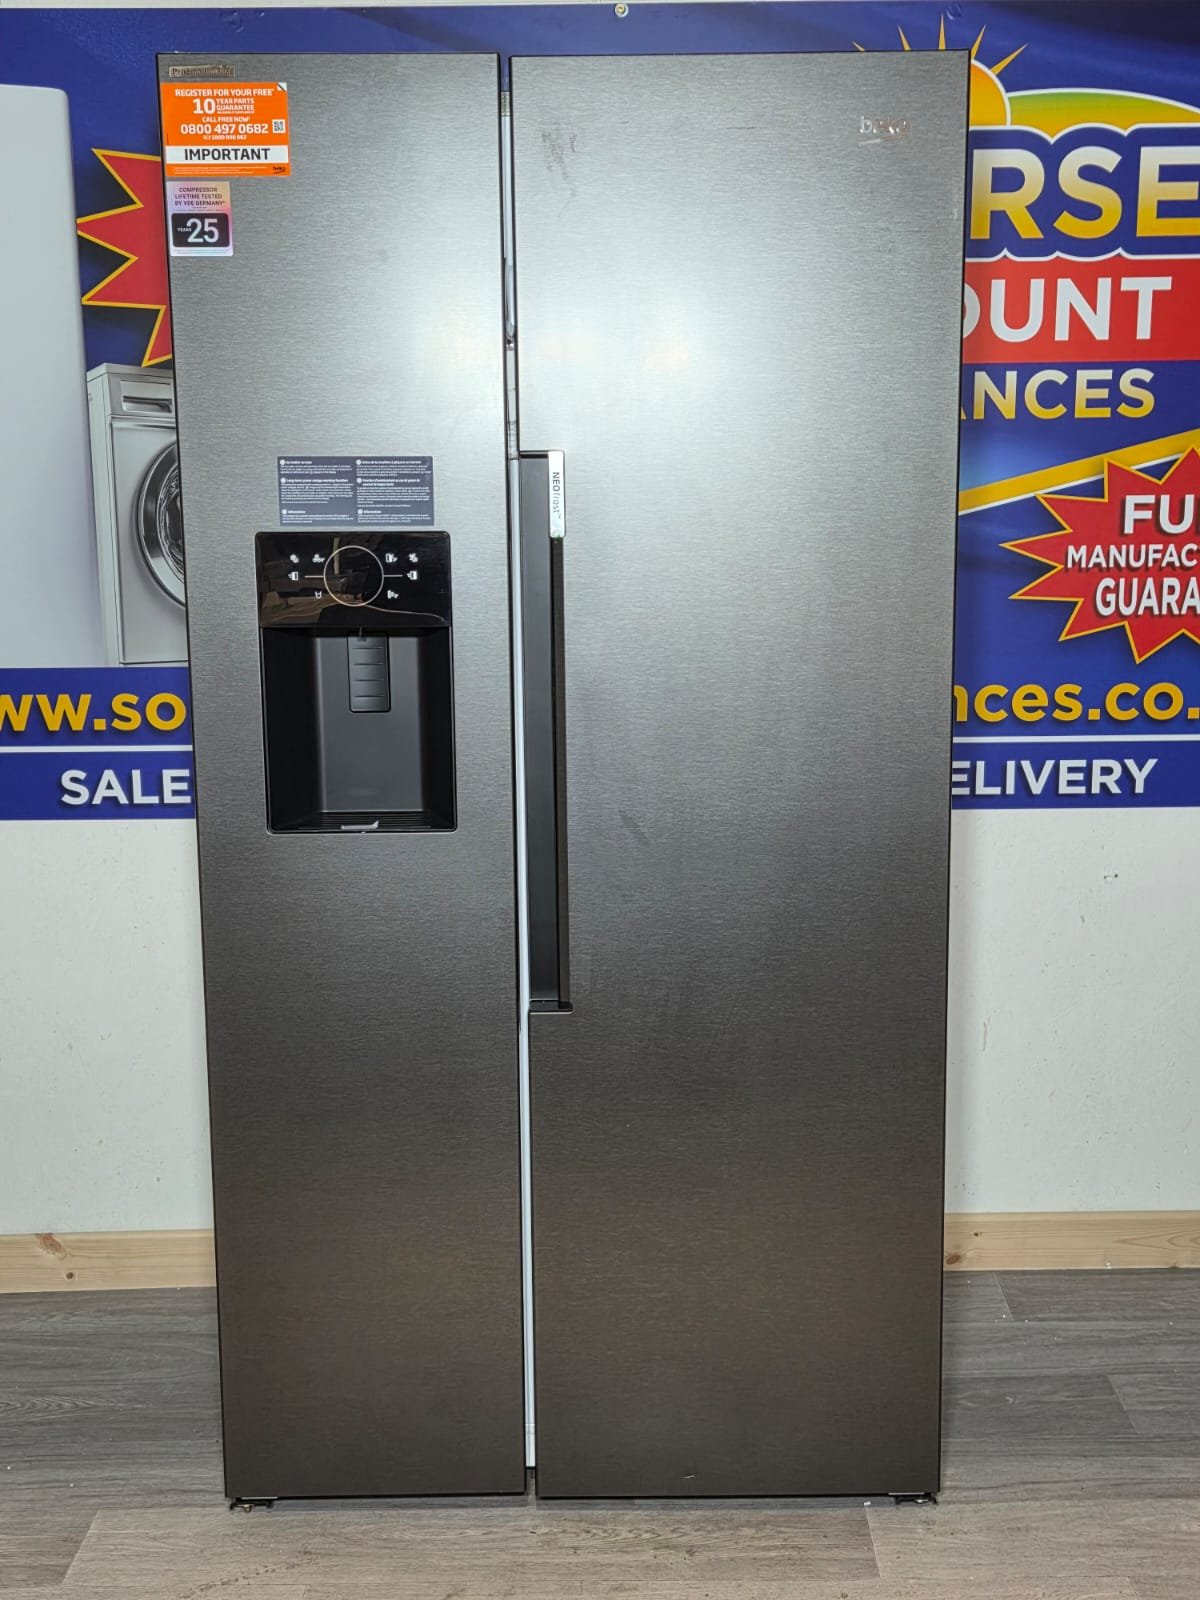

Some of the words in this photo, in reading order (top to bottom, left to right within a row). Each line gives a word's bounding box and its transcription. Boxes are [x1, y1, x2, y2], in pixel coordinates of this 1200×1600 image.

[175, 88, 213, 97] REGISTER
[213, 88, 230, 97] FOR
[230, 88, 252, 96] YOUR
[193, 98, 216, 114] 10
[180, 124, 212, 134] 0800
[214, 124, 236, 134] 497
[238, 123, 269, 134] 0682
[184, 148, 270, 161] IMPORTANT
[970, 146, 1200, 240] RSE
[186, 217, 219, 243] 25
[960, 367, 1155, 420] NCES
[1067, 543, 1200, 569] MANUFAC
[1095, 576, 1200, 616] GUARA
[61, 768, 192, 805] SALE
